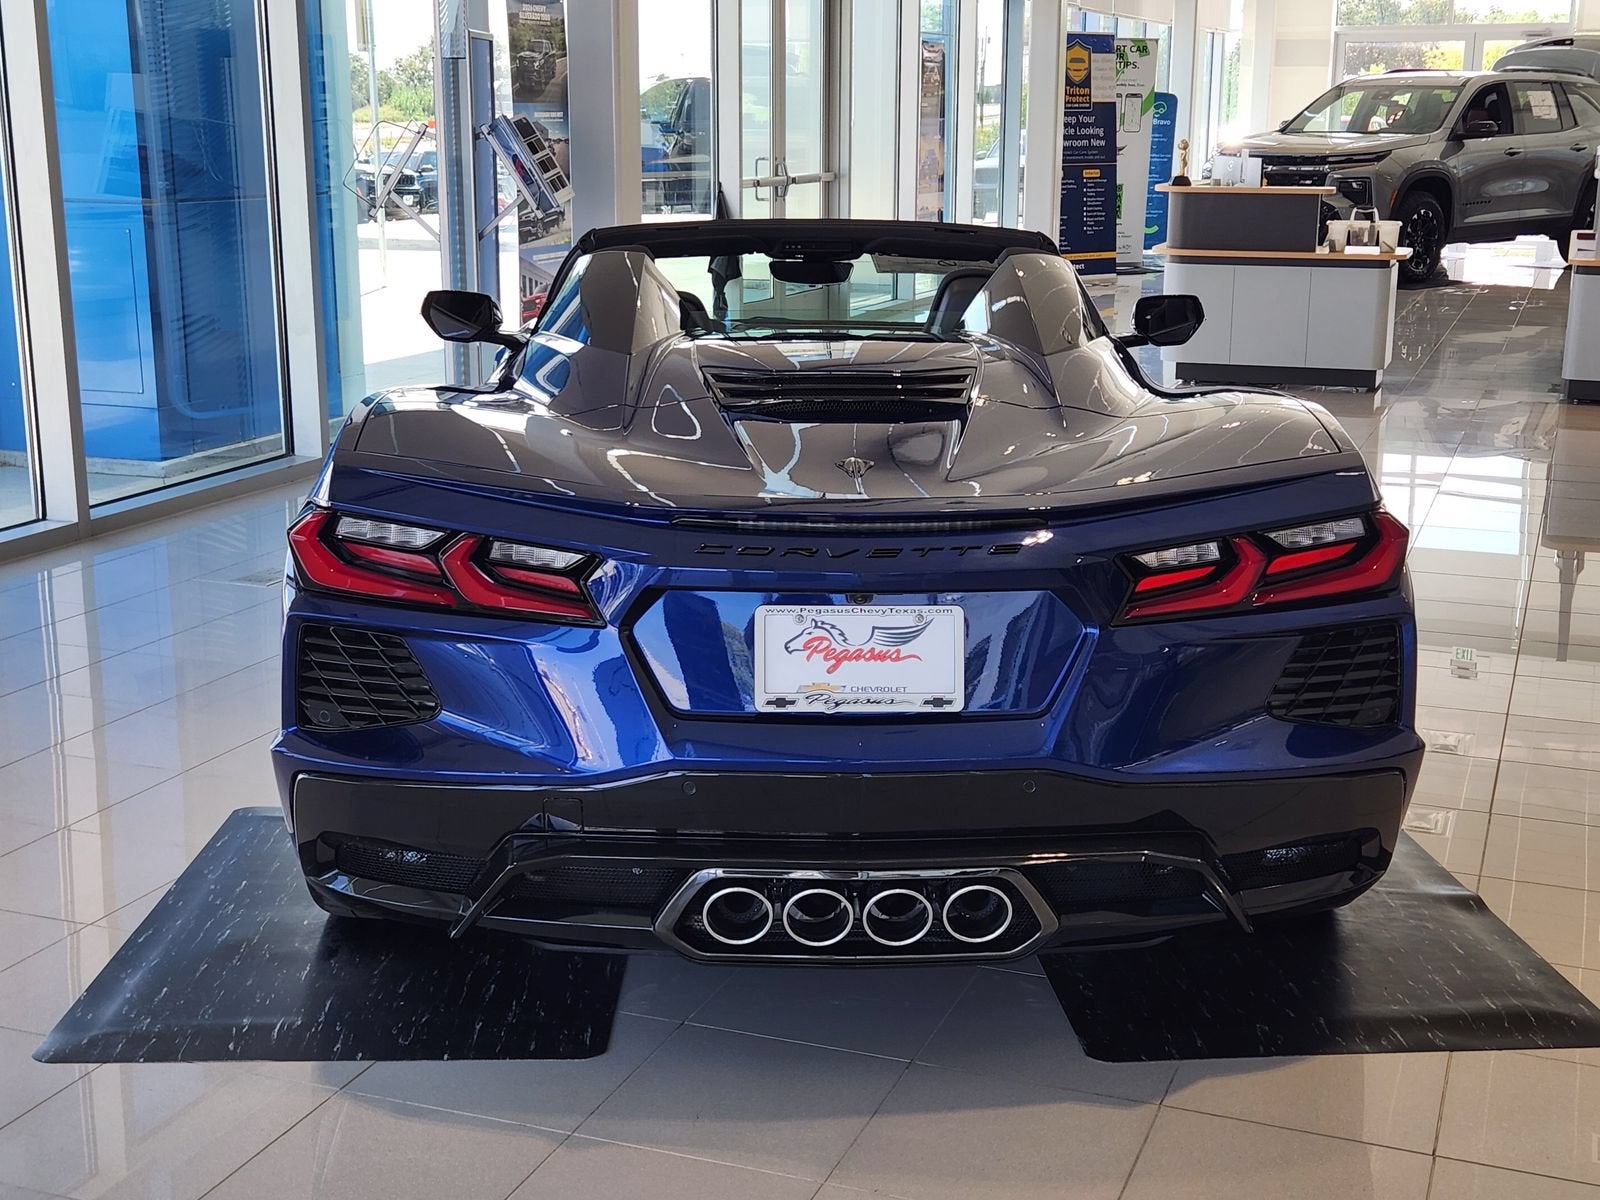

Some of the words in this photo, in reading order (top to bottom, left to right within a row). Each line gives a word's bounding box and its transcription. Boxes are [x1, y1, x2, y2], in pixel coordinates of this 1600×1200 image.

[1116, 44, 1127, 53] RT
[1130, 45, 1148, 53] CAR
[1116, 61, 1140, 70] TIPS.
[1066, 86, 1090, 95] Triton
[1066, 95, 1090, 103] Protect
[1064, 115, 1075, 125] eep
[1079, 114, 1096, 123] Your
[1064, 126, 1075, 134] cle
[1077, 127, 1105, 137] Looking
[1063, 140, 1089, 148] wroom
[694, 542, 1023, 559] CORVETTE
[765, 607, 953, 615] www.PegasusChevyTexas.com
[802, 636, 922, 674] Pegasus
[805, 693, 914, 710] Pegasus
